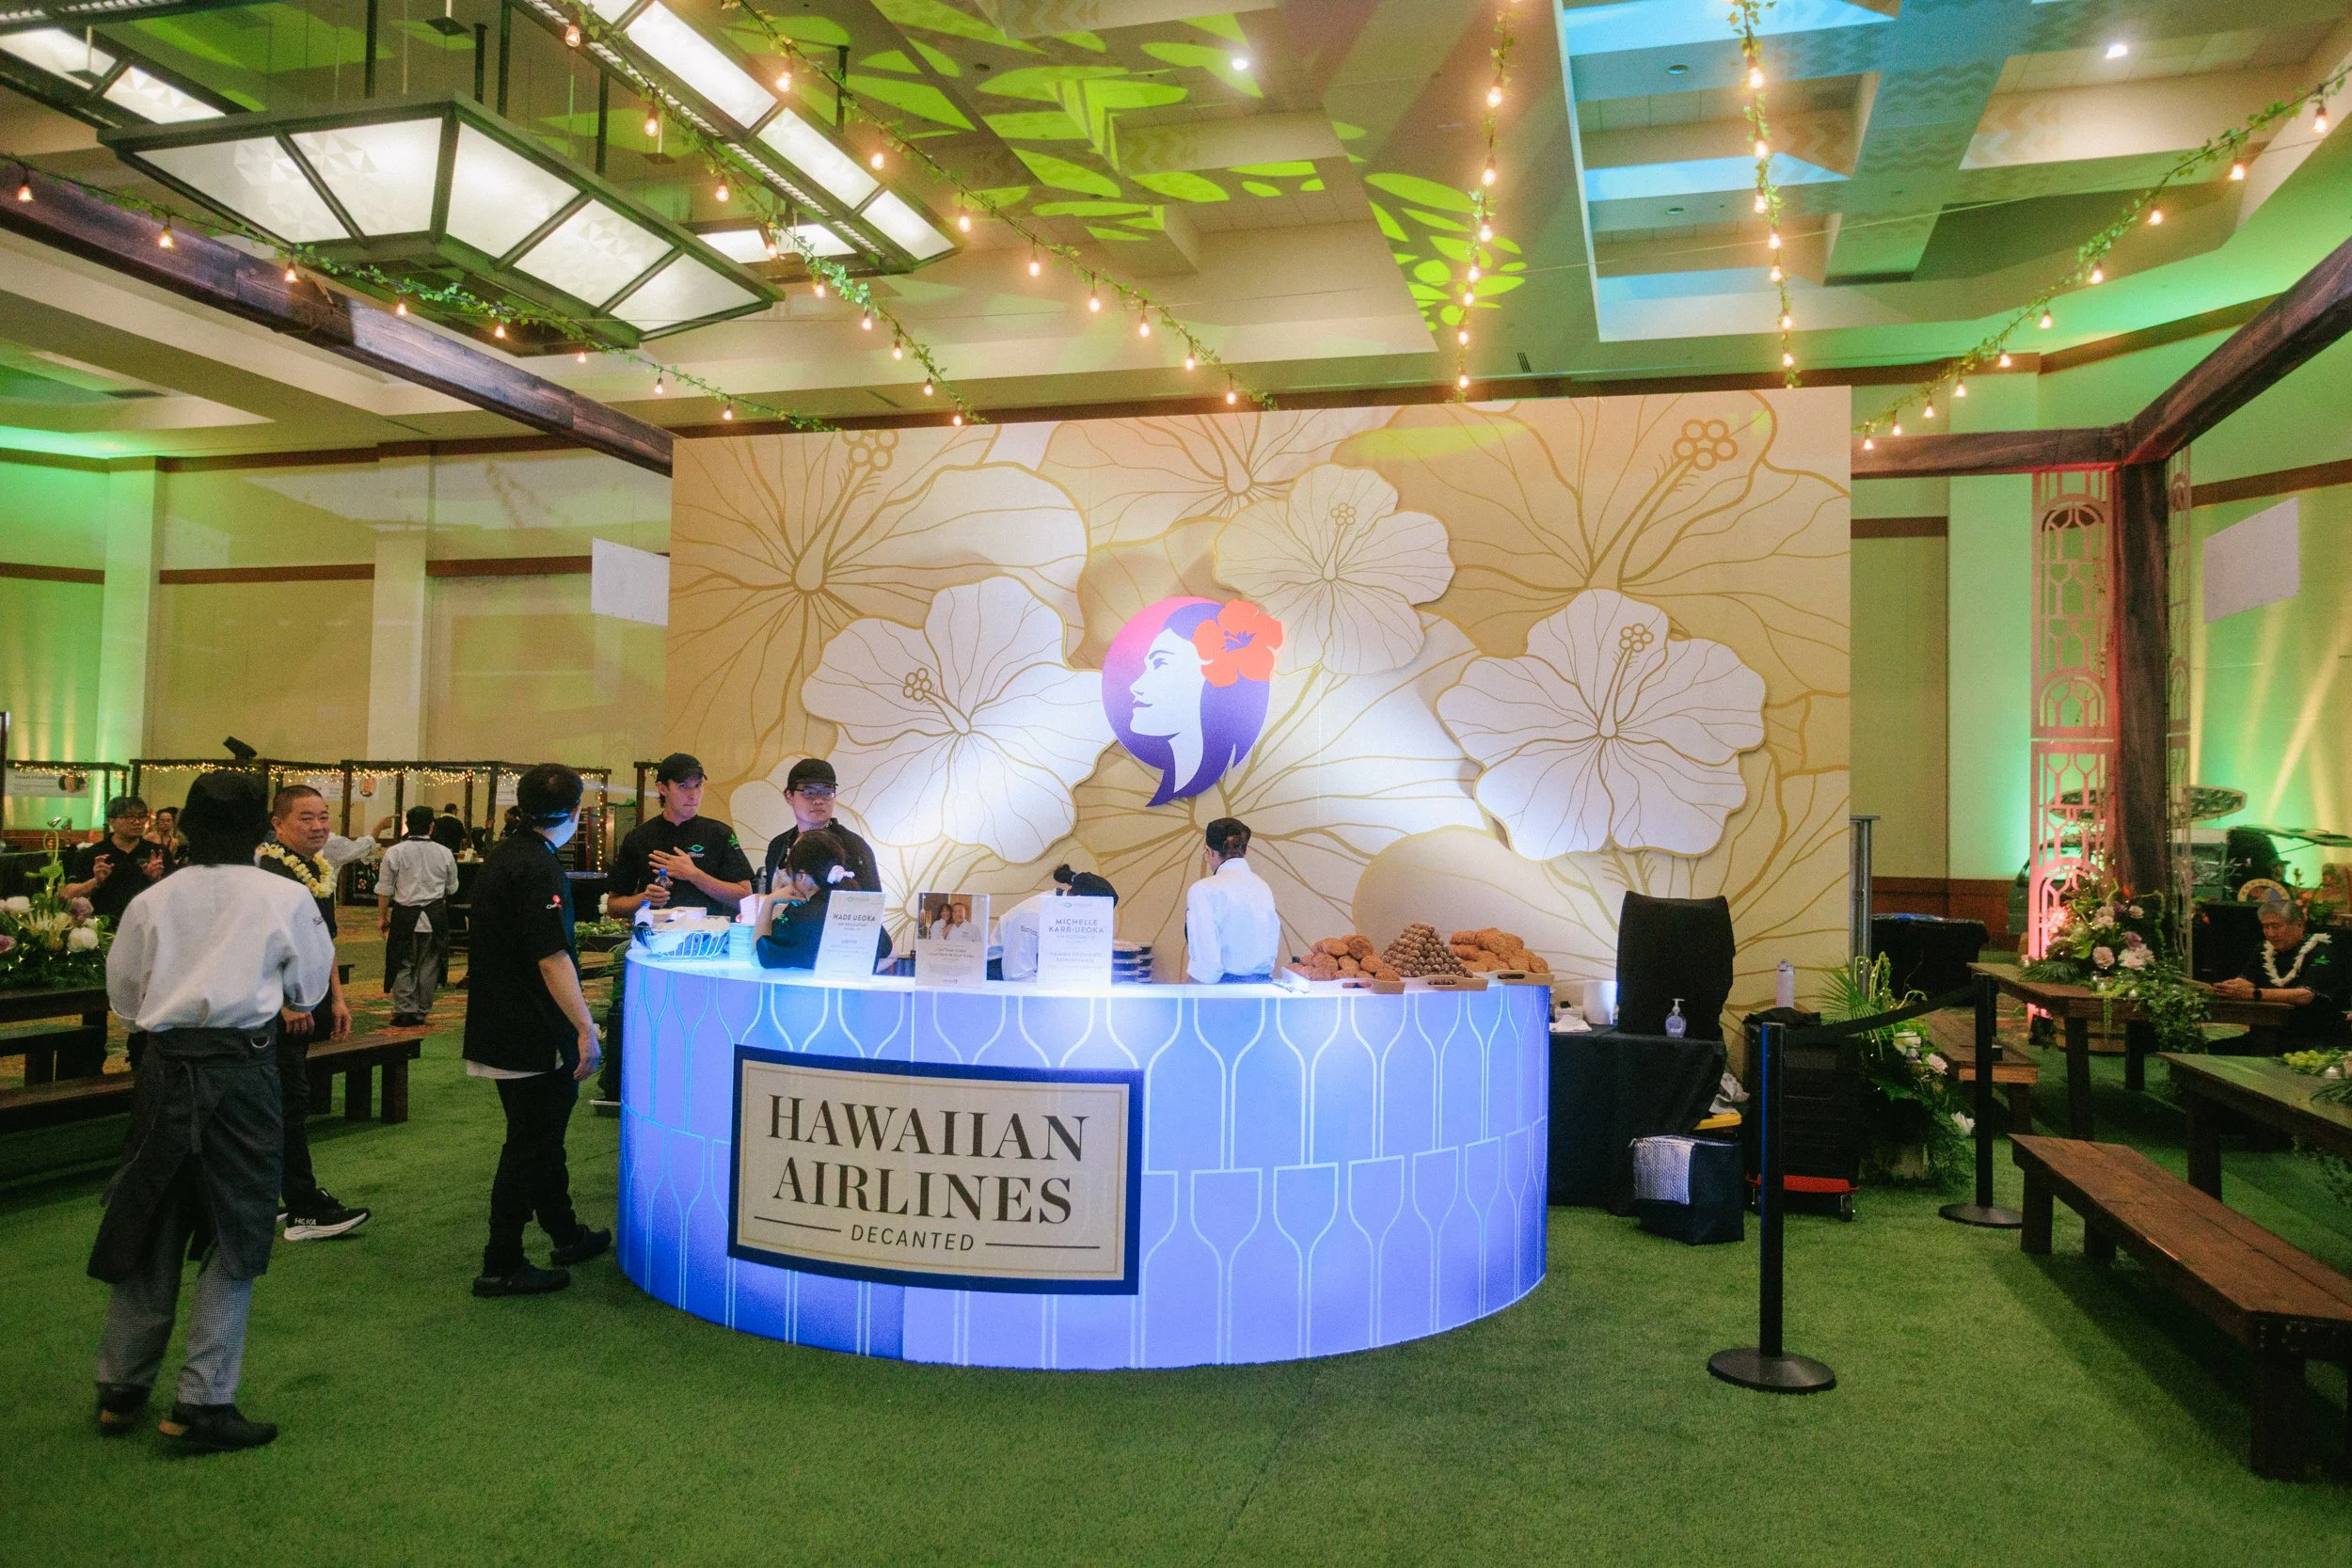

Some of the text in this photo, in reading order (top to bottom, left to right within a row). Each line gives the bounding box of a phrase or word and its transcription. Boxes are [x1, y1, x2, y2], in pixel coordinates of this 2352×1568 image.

[768, 1093, 1090, 1163] HAWAIIAN
[771, 1156, 1073, 1225] AIRLINES
[850, 1224, 975, 1252] DECANTED
